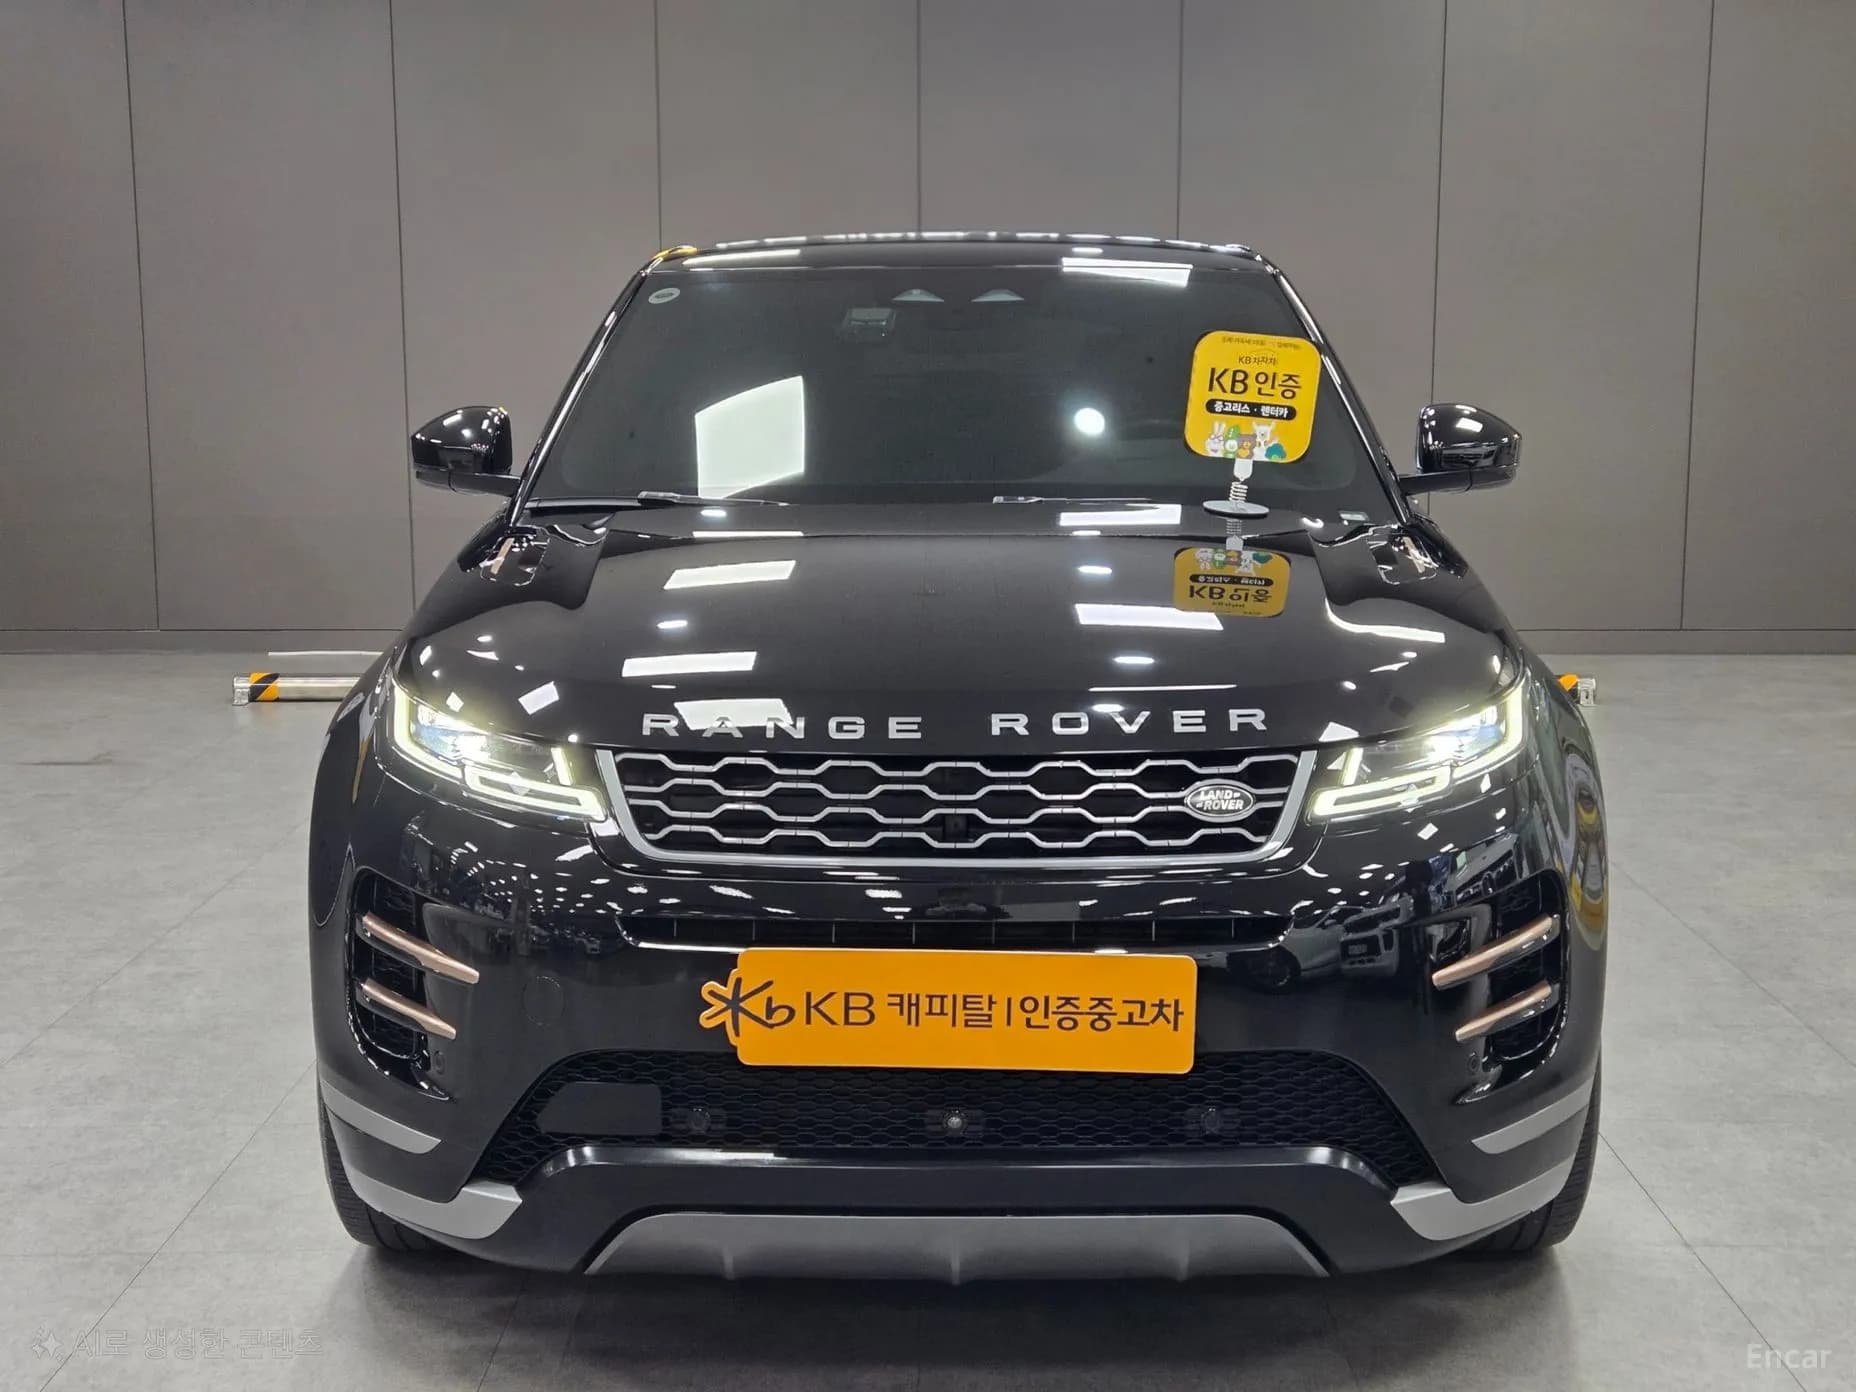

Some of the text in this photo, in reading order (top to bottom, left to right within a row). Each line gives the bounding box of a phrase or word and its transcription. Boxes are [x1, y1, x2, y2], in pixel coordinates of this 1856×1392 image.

[1208, 367, 1302, 400] KB 인증
[1213, 401, 1250, 414] 중고리스
[1261, 405, 1289, 418] 렌터카
[642, 708, 1267, 740] RANGE ROVER
[1200, 790, 1234, 800] LAND
[1203, 800, 1245, 811] ROVER
[805, 991, 876, 1026] KB
[887, 992, 997, 1029] 캐피탈
[1019, 994, 1185, 1032] 인증중고차
